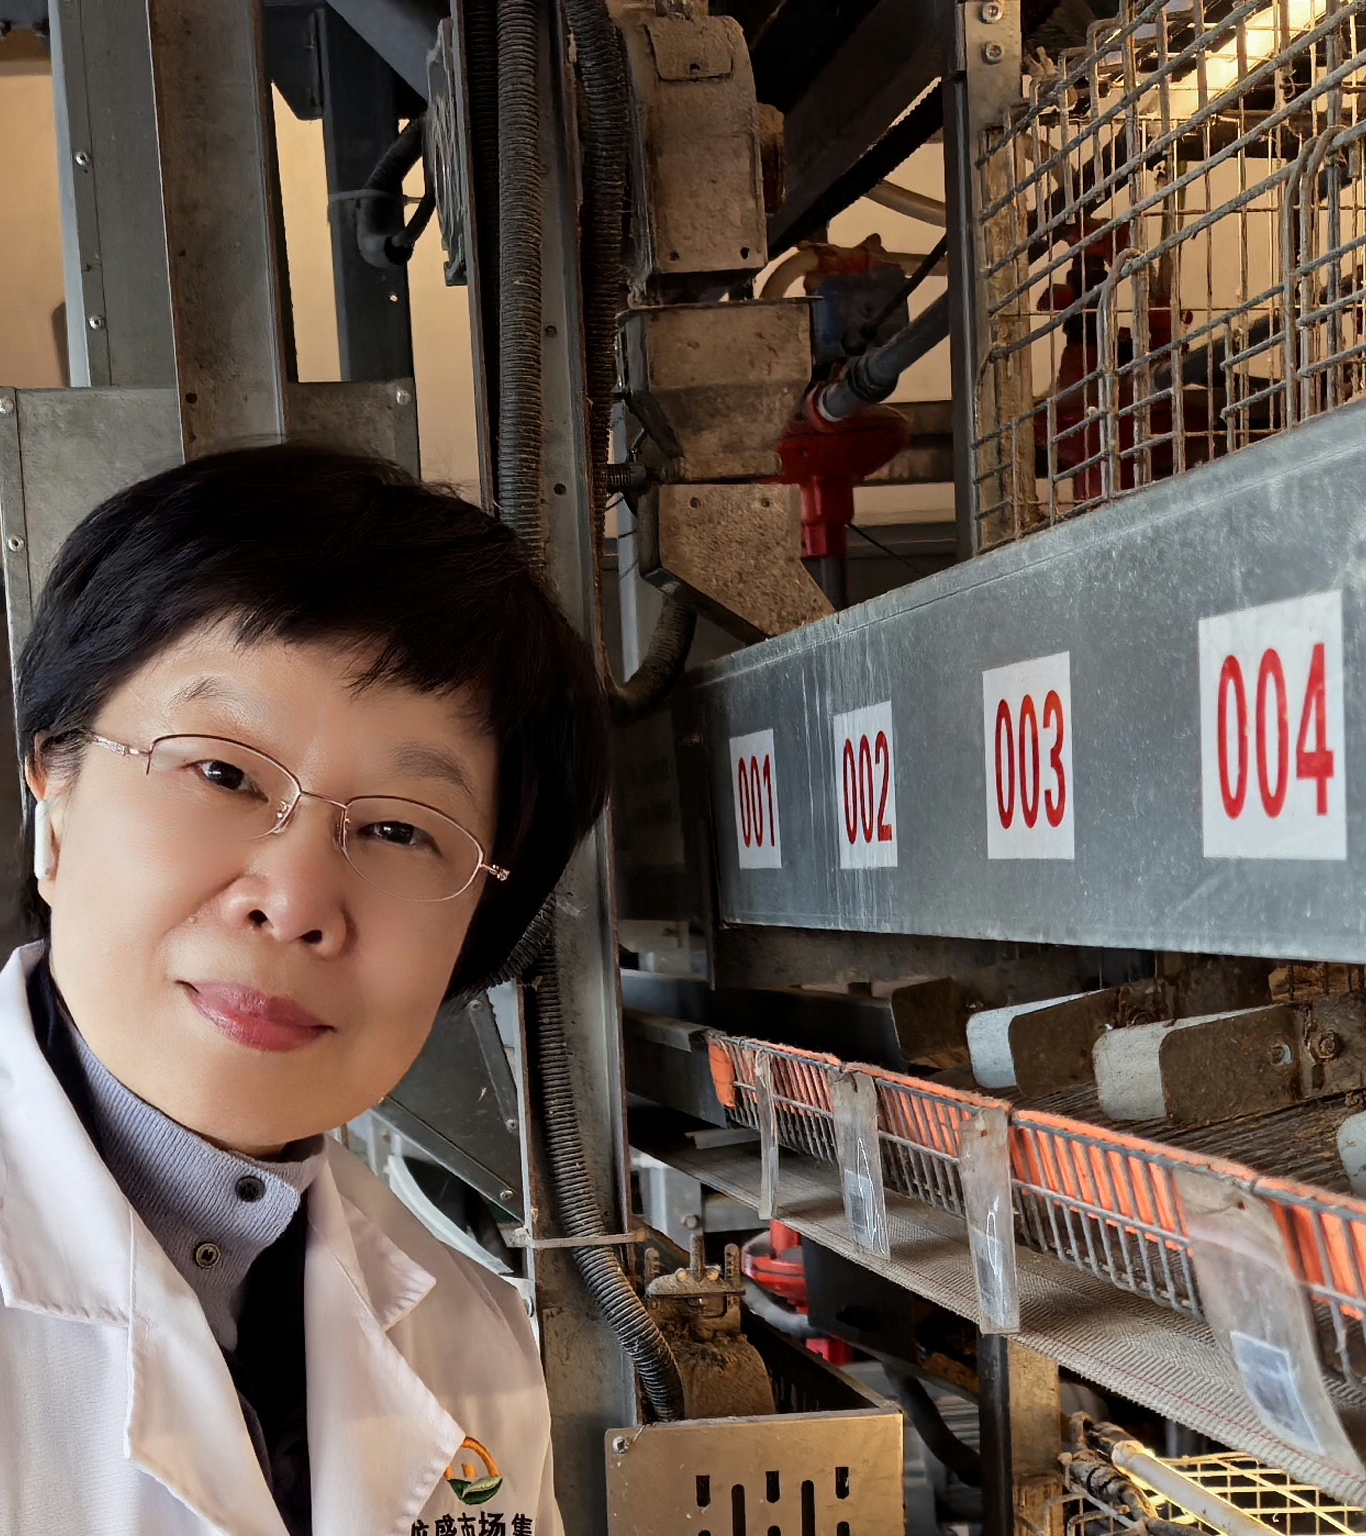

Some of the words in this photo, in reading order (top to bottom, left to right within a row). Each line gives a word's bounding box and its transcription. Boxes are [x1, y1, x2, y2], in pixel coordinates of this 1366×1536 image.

[843, 731, 893, 844] 002
[995, 690, 1067, 829] 003
[1217, 643, 1335, 820] 004
[738, 755, 774, 847] 001
